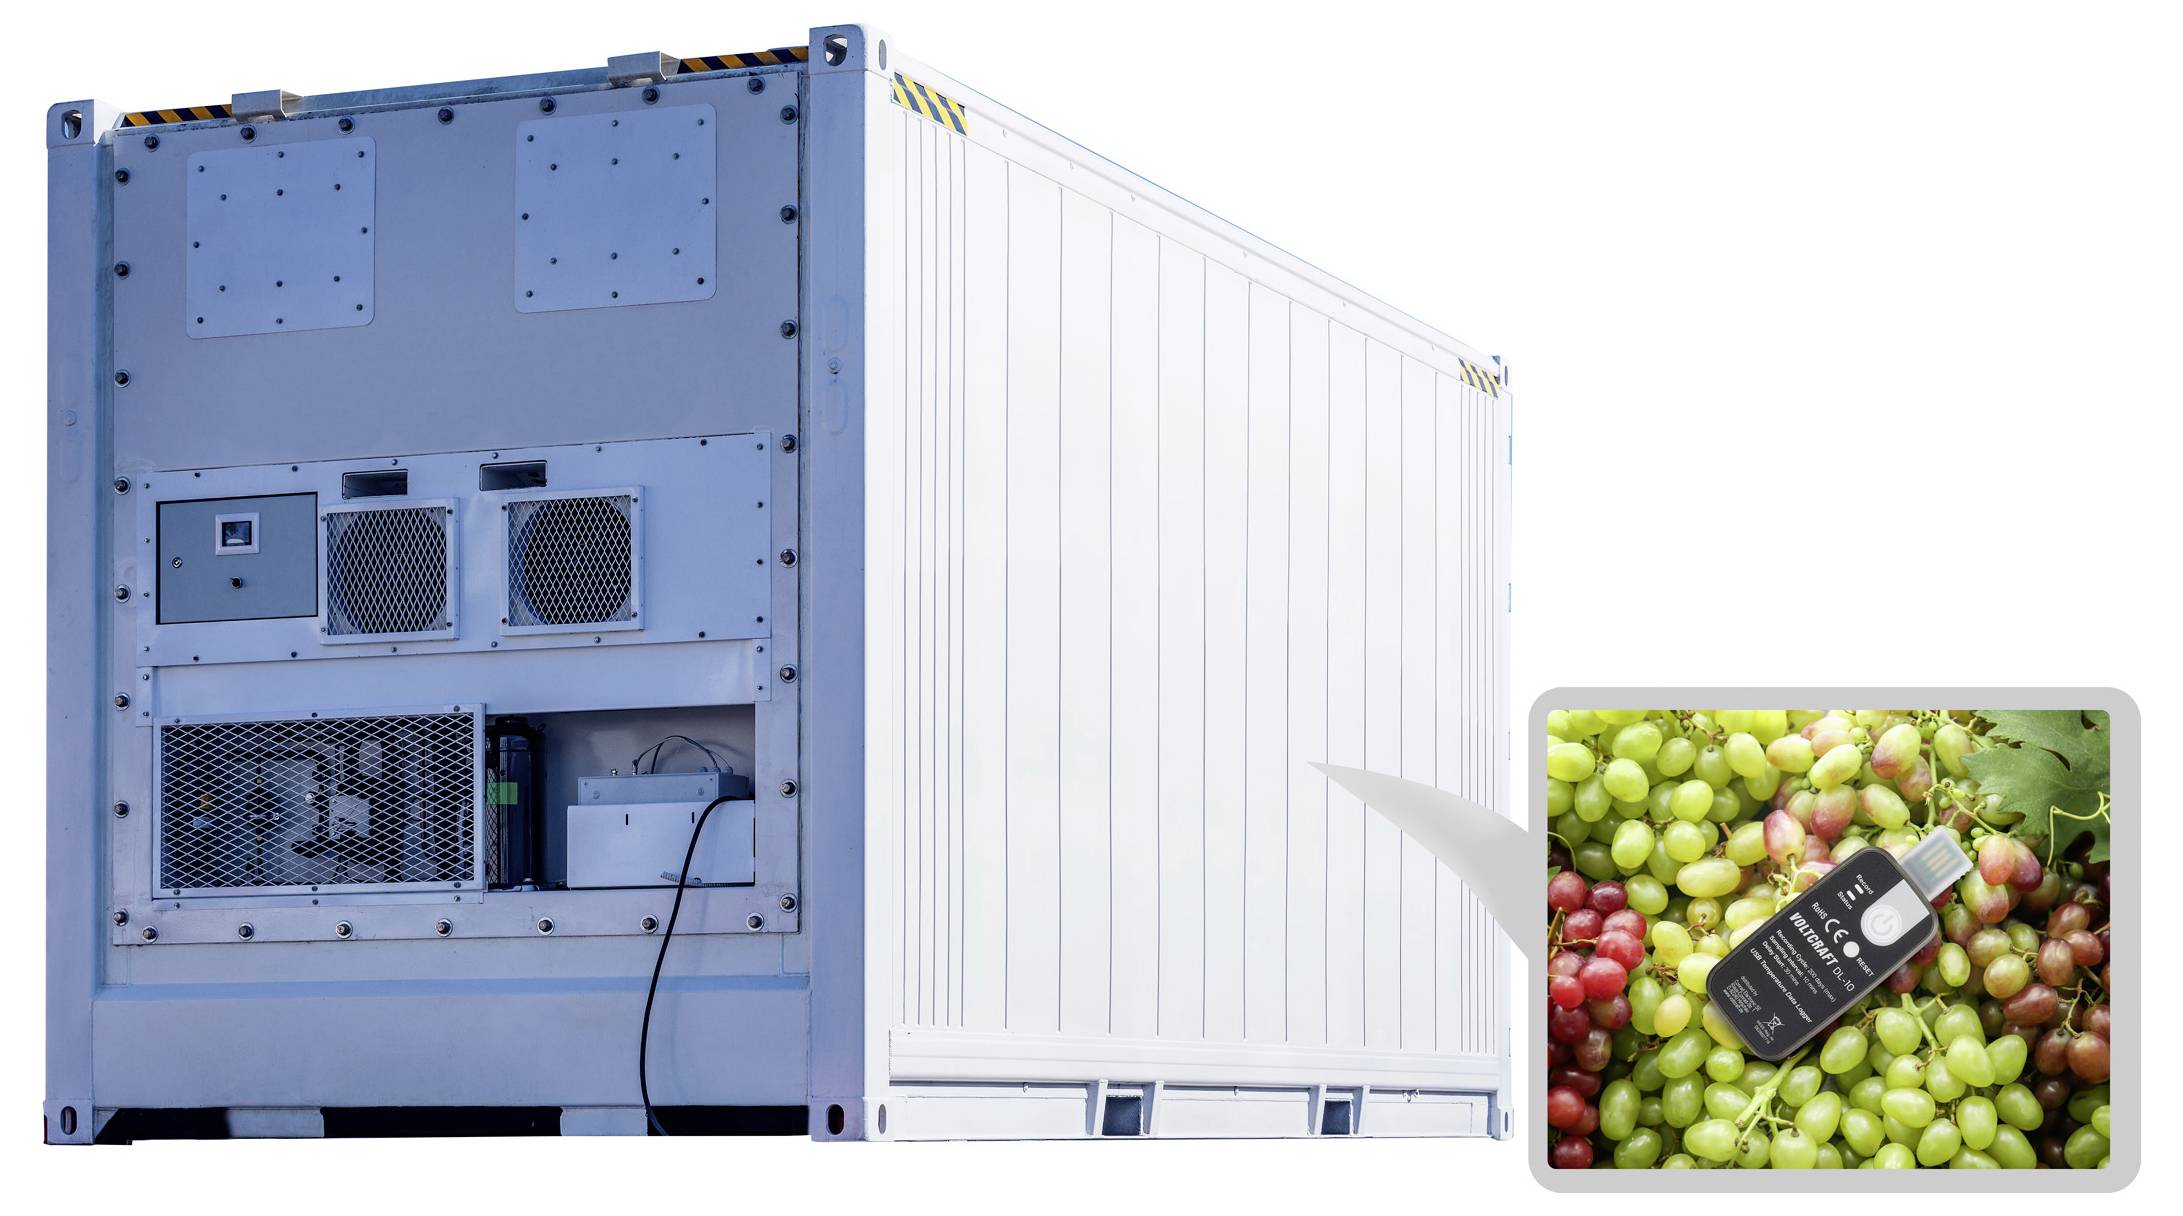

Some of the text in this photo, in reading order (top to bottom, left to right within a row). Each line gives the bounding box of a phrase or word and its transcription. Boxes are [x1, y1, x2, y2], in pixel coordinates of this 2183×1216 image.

[1855, 873, 1874, 895] Record
[1810, 901, 1828, 920] RoHS
[1836, 890, 1853, 910] Status
[1768, 934, 1789, 959] Sampling
[1775, 928, 1797, 955] Recording
[1788, 910, 1855, 992] VOLTCRAFT DL-10
[1855, 956, 1874, 977] RESET
[1749, 947, 1813, 1024] USB Temperature Data Logger
